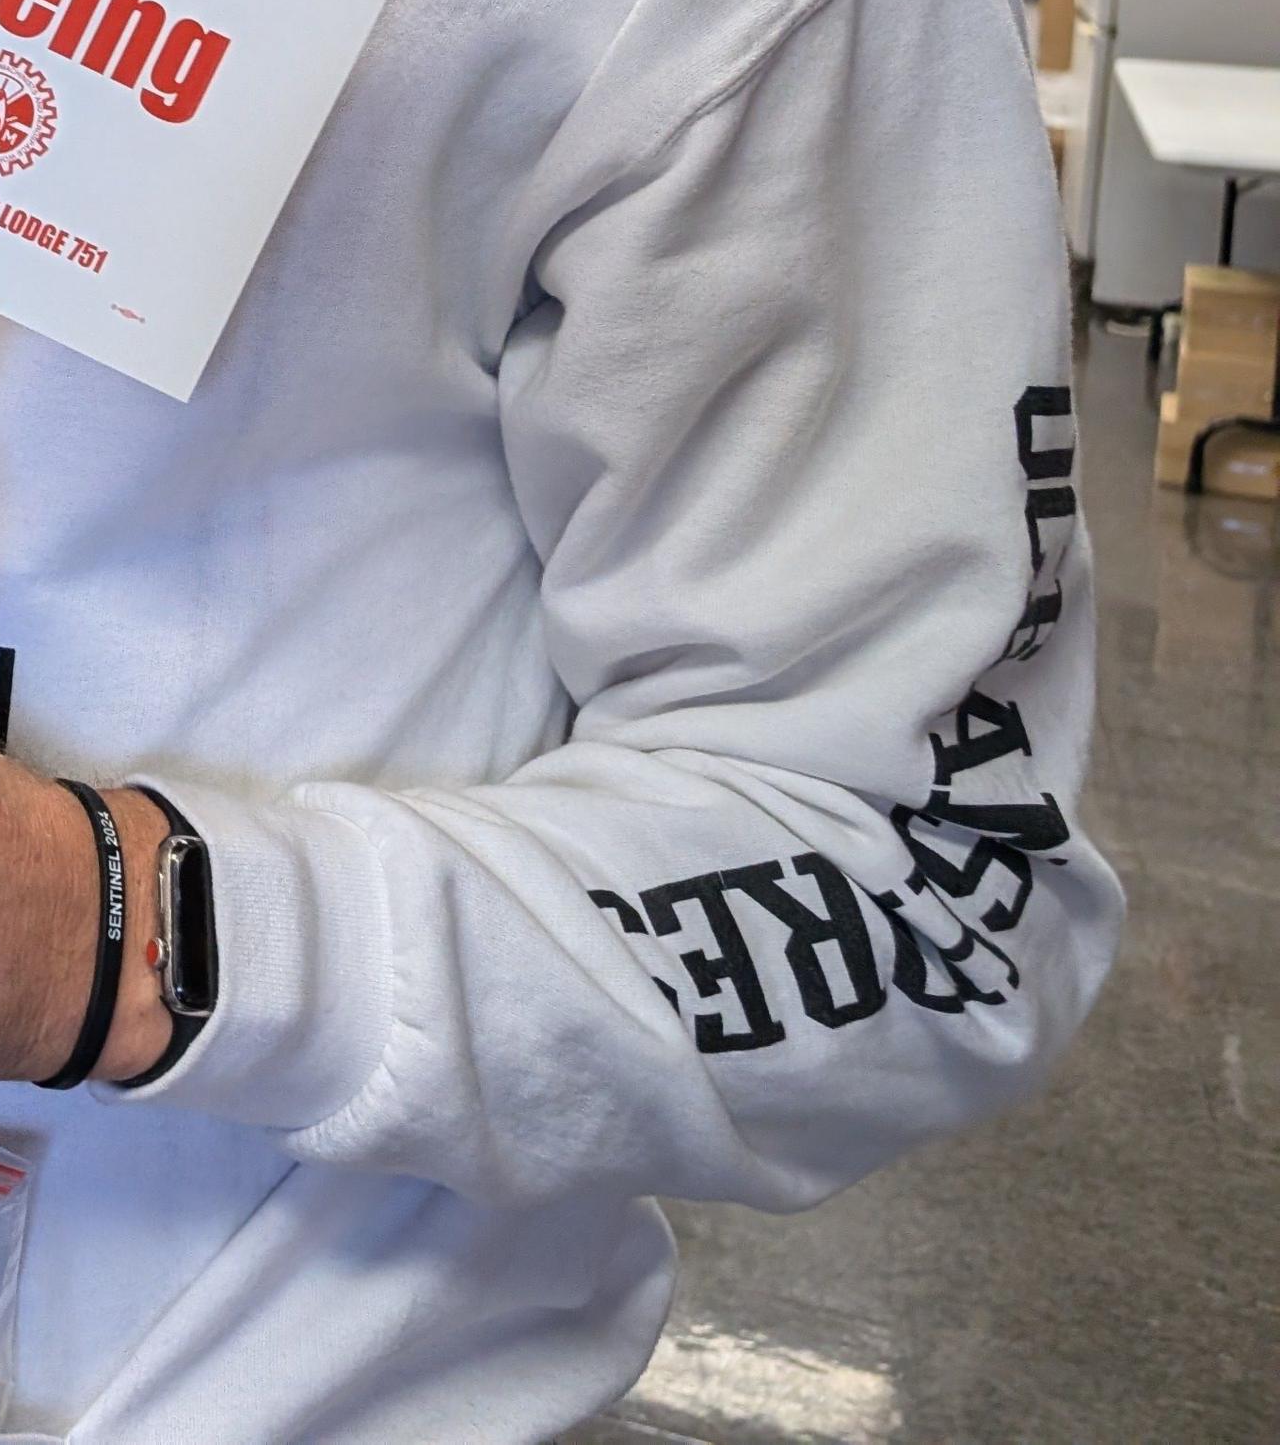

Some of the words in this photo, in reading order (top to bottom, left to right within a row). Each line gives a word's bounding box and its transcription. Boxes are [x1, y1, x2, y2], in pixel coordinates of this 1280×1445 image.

[65, 236, 109, 274] 751
[97, 809, 119, 850] 2024
[107, 850, 124, 941] SENTINEL
